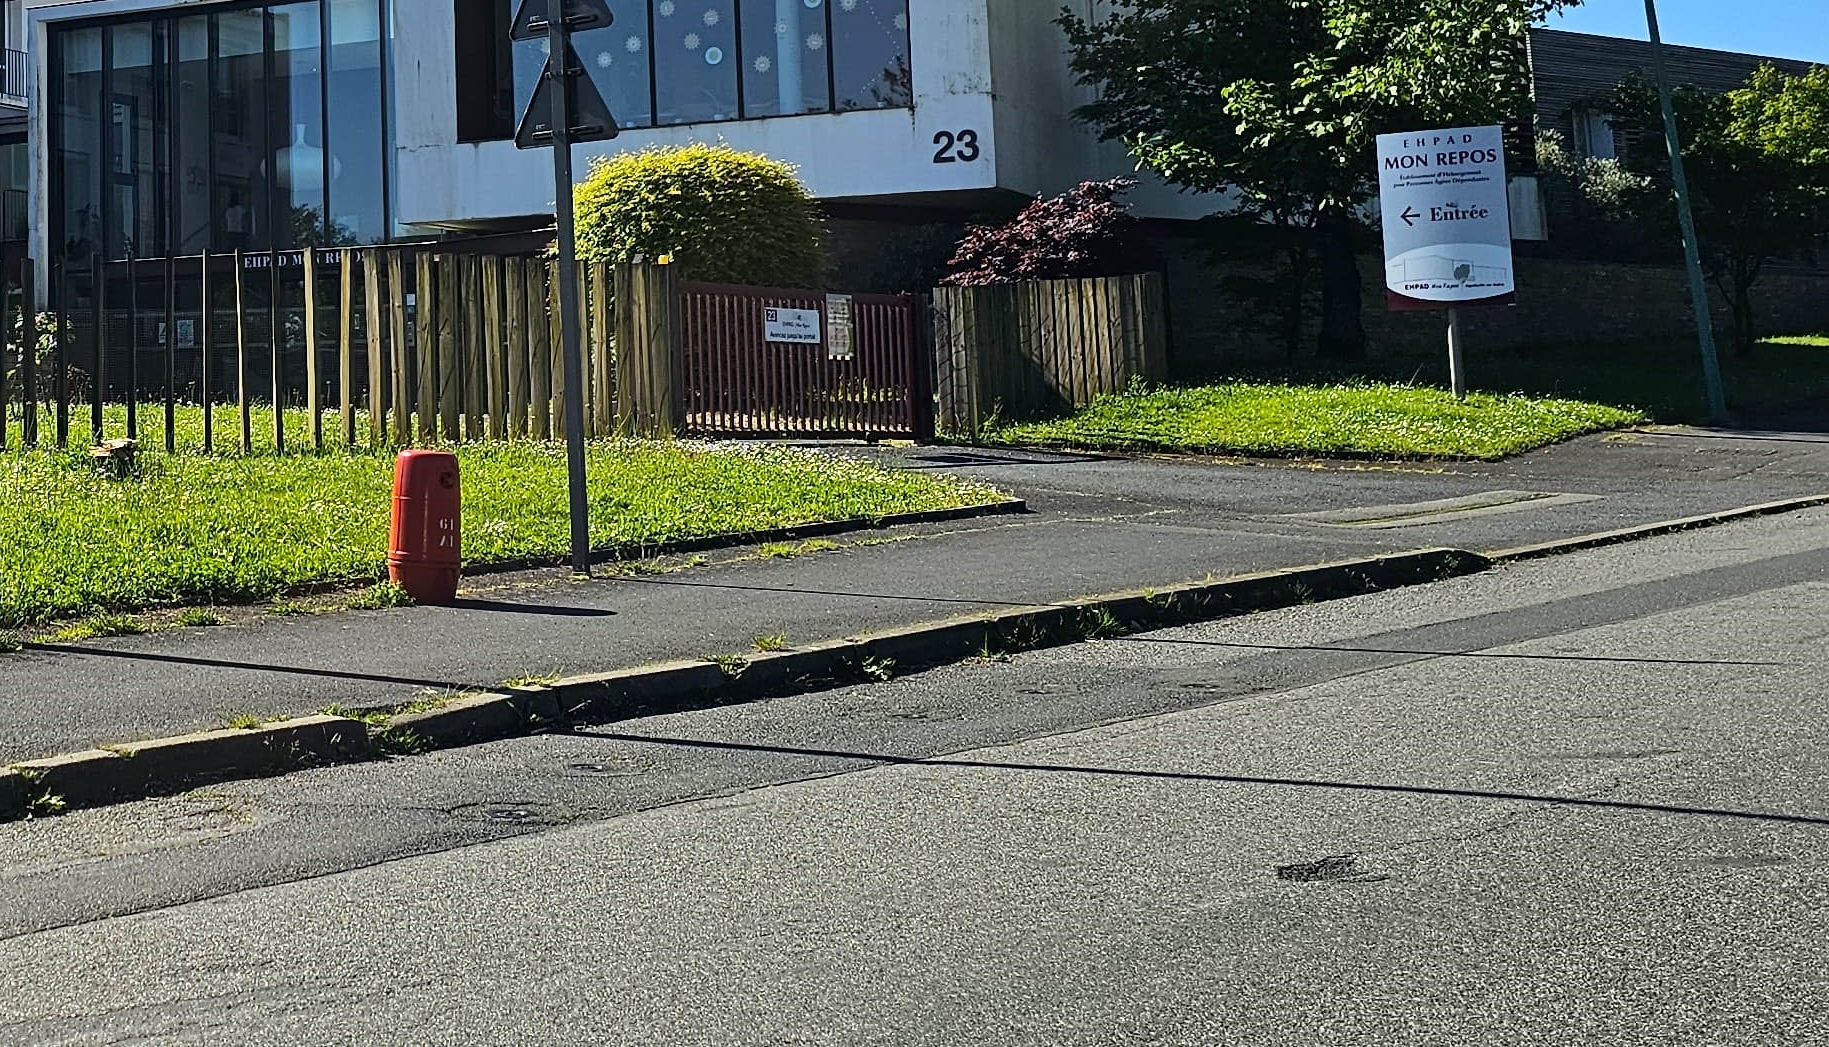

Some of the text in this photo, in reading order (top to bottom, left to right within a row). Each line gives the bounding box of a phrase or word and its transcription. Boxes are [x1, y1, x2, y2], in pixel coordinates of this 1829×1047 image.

[932, 128, 980, 164] 23
[1384, 148, 1497, 170] MON REPOS
[1430, 204, 1489, 222] Entrée
[243, 254, 287, 269] EHPD
[767, 310, 776, 321] 23
